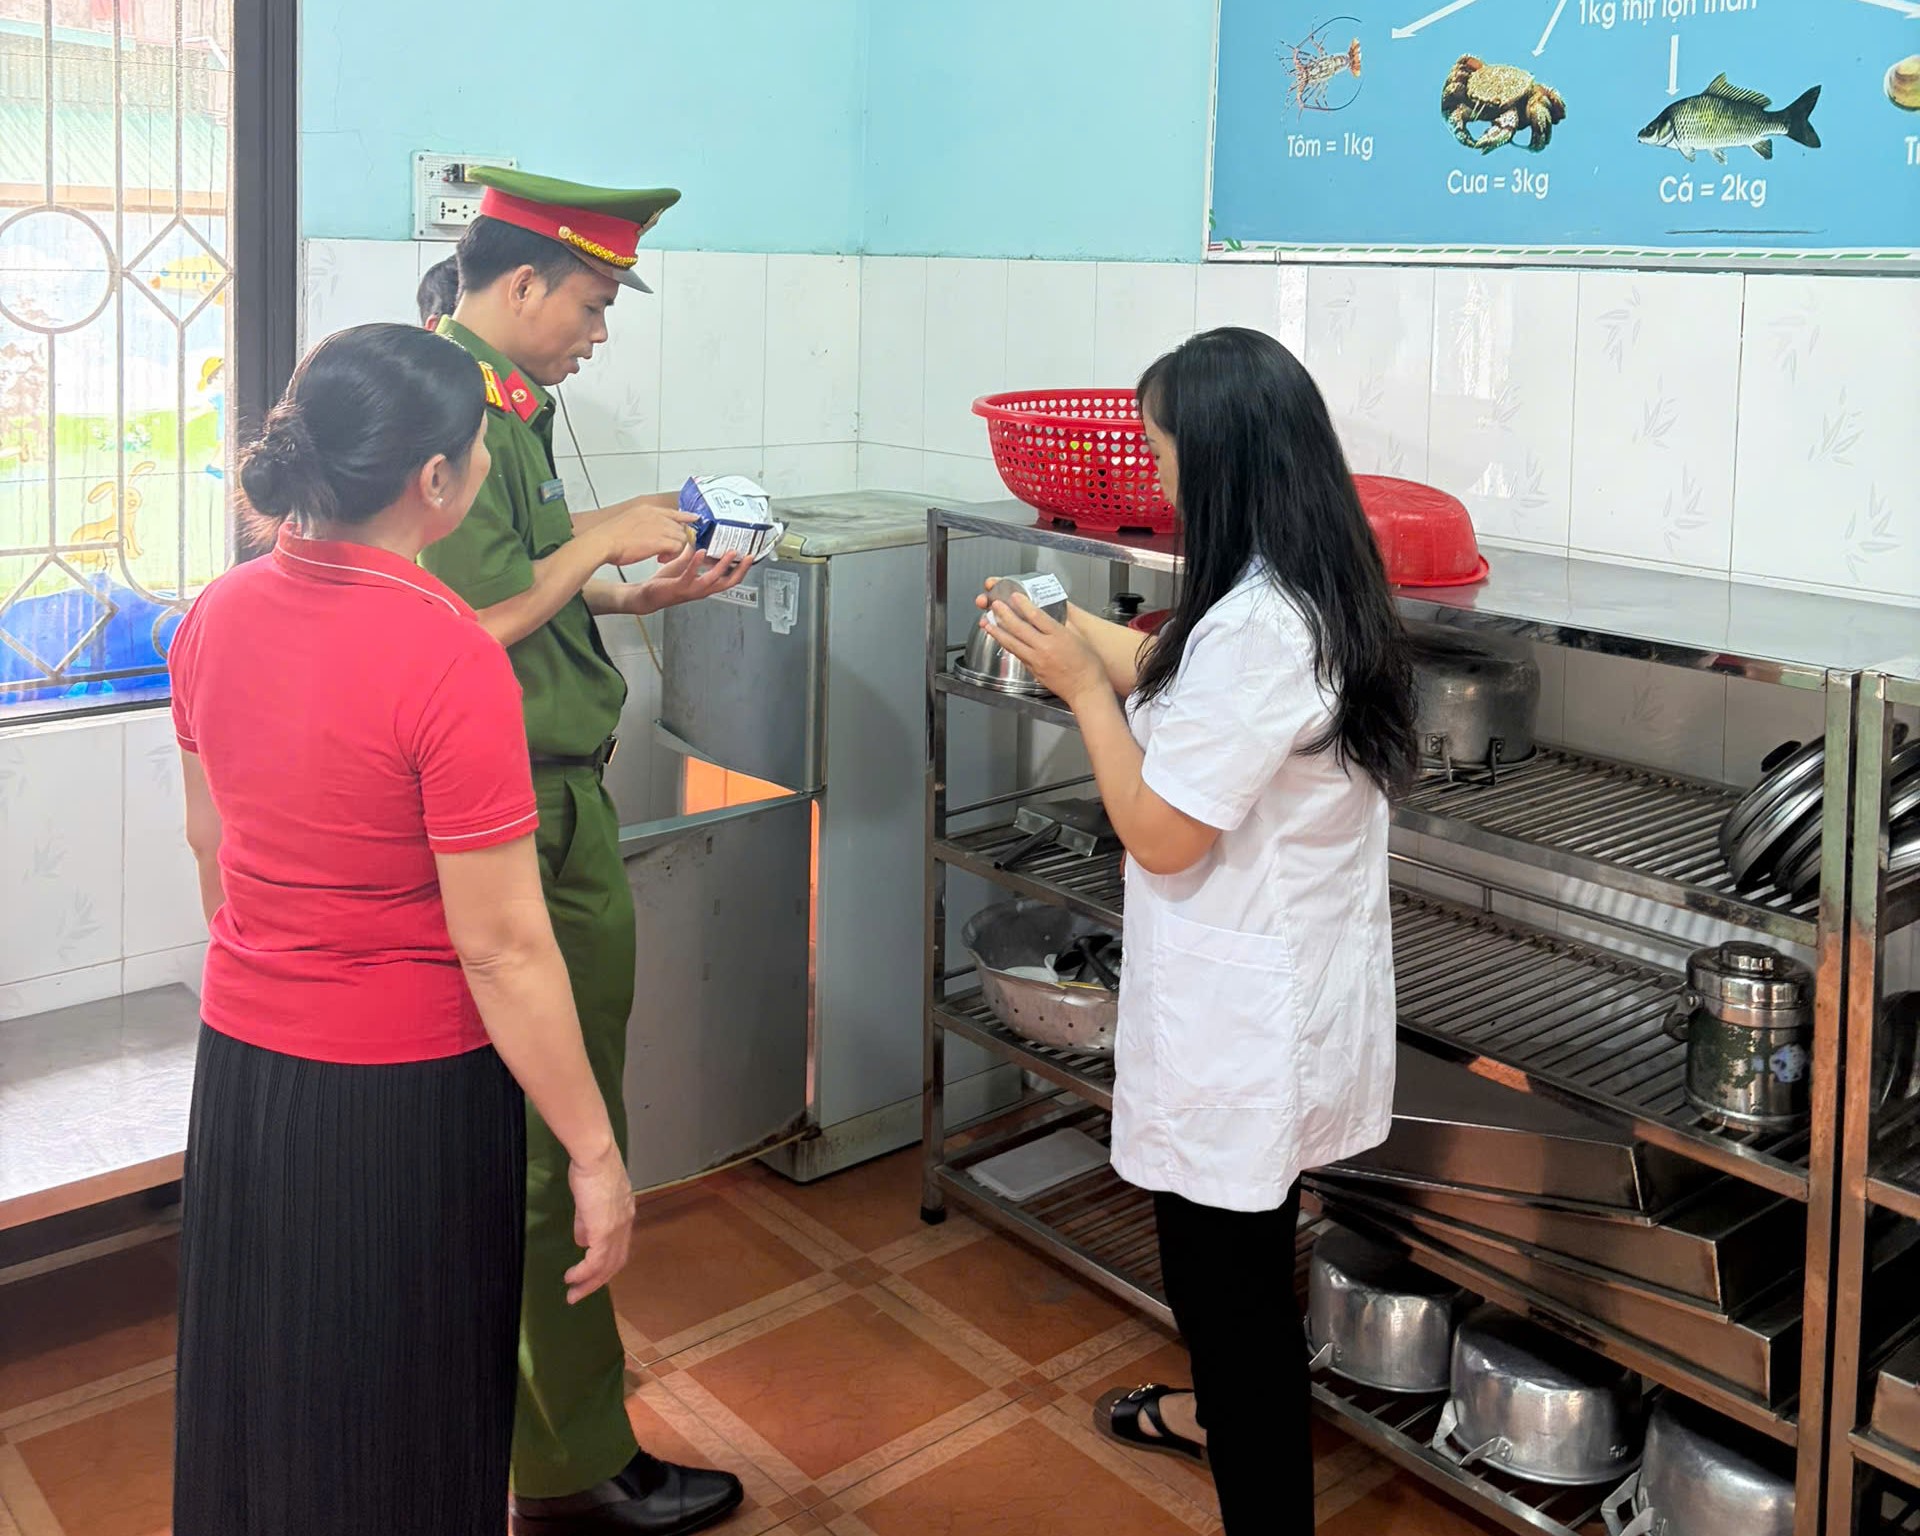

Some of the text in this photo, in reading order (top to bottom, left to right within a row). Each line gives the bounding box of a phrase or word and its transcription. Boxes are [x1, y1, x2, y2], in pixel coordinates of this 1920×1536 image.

[1579, 0, 1616, 29] 1kg
[1287, 134, 1321, 158] Tôm
[1343, 132, 1374, 161] 1kg
[1447, 169, 1488, 194] Cua
[1511, 167, 1549, 200] 3kg
[1659, 172, 1694, 203] Cá
[1721, 172, 1767, 208] 2kg
